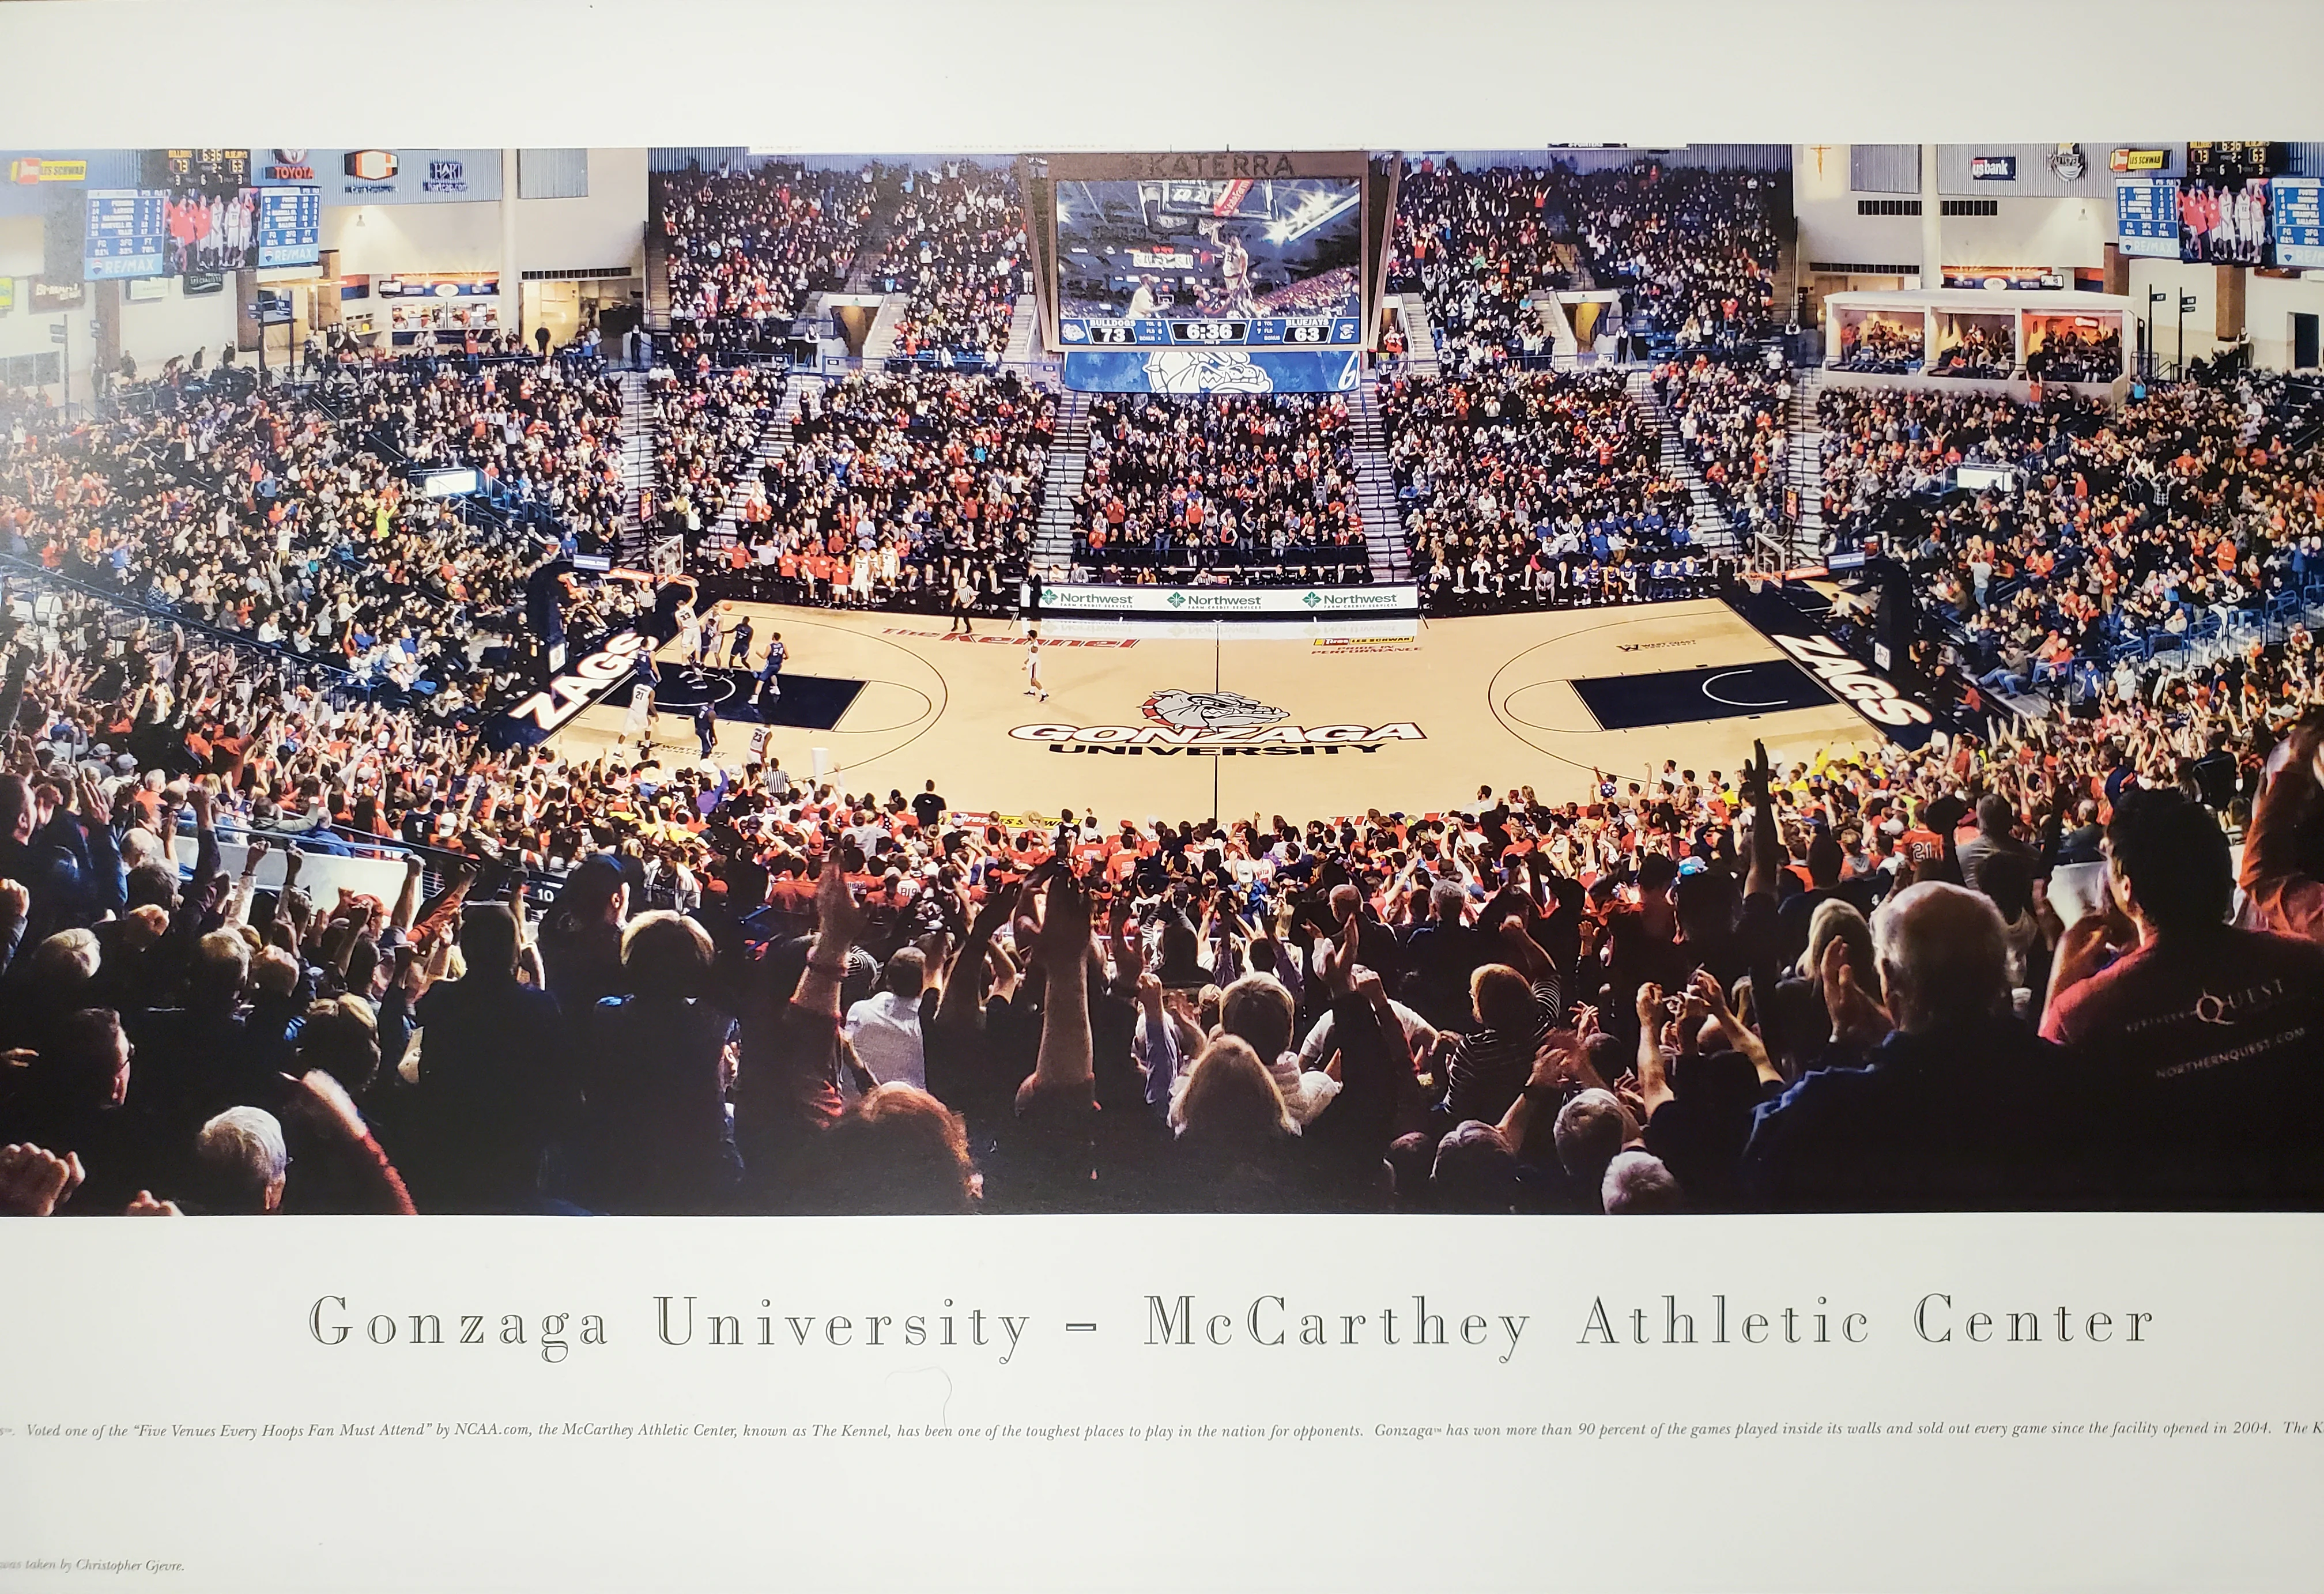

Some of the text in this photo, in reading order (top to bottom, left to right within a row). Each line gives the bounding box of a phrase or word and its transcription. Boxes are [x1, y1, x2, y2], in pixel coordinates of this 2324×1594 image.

[202, 149, 222, 161] 6:36
[2198, 150, 2208, 163] 73
[2253, 149, 2265, 162] 63
[177, 160, 188, 172] 73
[232, 160, 243, 172] 63
[275, 167, 314, 179] TOYOTA
[2134, 241, 2172, 254] RE/MAX
[274, 248, 312, 261] RE/MAX
[105, 259, 154, 274] RE/MAX
[1101, 328, 1126, 342] 73
[1187, 324, 1232, 339] 6:36
[1295, 327, 1319, 341] 63
[1061, 593, 1133, 603] Northwest
[1189, 595, 1261, 605] Northwest
[1325, 594, 1397, 604] Northwest
[680, 613, 691, 621] 33
[882, 628, 1141, 648] The Kennel
[772, 648, 783, 656] 24
[1311, 647, 1423, 655] PERFORMANCE
[508, 633, 659, 730] ZAGS
[1771, 634, 1933, 725] ZAGS
[635, 691, 644, 700] 21
[753, 732, 763, 742] 23
[1009, 722, 1428, 745] GONZAGA
[662, 745, 692, 753] WEST
[1049, 743, 1387, 756] UNIVERSITY
[1912, 841, 1931, 862] 21
[537, 888, 554, 902] 10
[2197, 978, 2283, 1025] QUEST
[310, 1296, 608, 1363] Gonzaga
[653, 1297, 1030, 1365] University
[1144, 1295, 1530, 1364] McCarthey
[1576, 1295, 1868, 1344] Athletic
[1914, 1294, 2152, 1343] Center
[28, 1425, 61, 1436] Voted
[92, 1425, 106, 1441] of
[109, 1425, 127, 1437] the
[134, 1425, 167, 1437] “Five
[172, 1425, 216, 1437] Venues
[220, 1425, 257, 1441] Every
[262, 1425, 304, 1441] Hoops
[308, 1425, 334, 1437] Fan
[339, 1425, 375, 1436] Must
[379, 1423, 432, 1436] Attend”
[436, 1423, 450, 1440] by
[454, 1423, 531, 1437] NCAA.com,
[539, 1423, 558, 1435] the
[562, 1423, 633, 1440] McCarthey
[637, 1424, 688, 1436] Athletic
[694, 1425, 737, 1439] Center,
[744, 1425, 787, 1437] known
[813, 1425, 836, 1437] The
[841, 1425, 891, 1439] Kennel,
[897, 1425, 920, 1437] has
[925, 1425, 952, 1437] been
[959, 1429, 980, 1437] one
[986, 1425, 999, 1441] of
[1002, 1425, 1021, 1437] the
[1027, 1425, 1080, 1441] toughest
[1084, 1425, 1124, 1441] places
[1130, 1427, 1141, 1437] to
[1145, 1425, 1173, 1441] play
[1179, 1425, 1191, 1437] in
[1198, 1425, 1217, 1437] the
[1222, 1425, 1265, 1437] nation
[1268, 1425, 1289, 1441] for
[1294, 1426, 1363, 1441] opponents.
[1446, 1424, 1469, 1436] has
[1474, 1428, 1500, 1436] won
[1507, 1427, 1537, 1436] more
[1542, 1423, 1572, 1436] than
[1579, 1423, 1595, 1436] 90
[1599, 1425, 1645, 1440] percent
[1651, 1423, 1665, 1439] of
[1667, 1423, 1687, 1435] the
[1690, 1427, 1730, 1439] games
[1735, 1423, 1778, 1439] played
[1783, 1423, 1823, 1434] inside
[1828, 1423, 1842, 1434] its
[1848, 1422, 1881, 1434] walls
[1887, 1422, 1913, 1434] and
[1918, 1422, 1944, 1434] sold
[1949, 1424, 1970, 1434] out
[1975, 1426, 2007, 1438] every
[2012, 1426, 2047, 1438] game
[2051, 1422, 2084, 1434] since
[2089, 1422, 2108, 1434] the
[2112, 1422, 2158, 1438] facility
[2164, 1422, 2209, 1438] opened
[2214, 1422, 2227, 1434] in
[2233, 1422, 2271, 1434] 2004.
[2284, 1422, 2308, 1434] The
[25, 1559, 184, 1575] taken by Christopher Gjevre.
